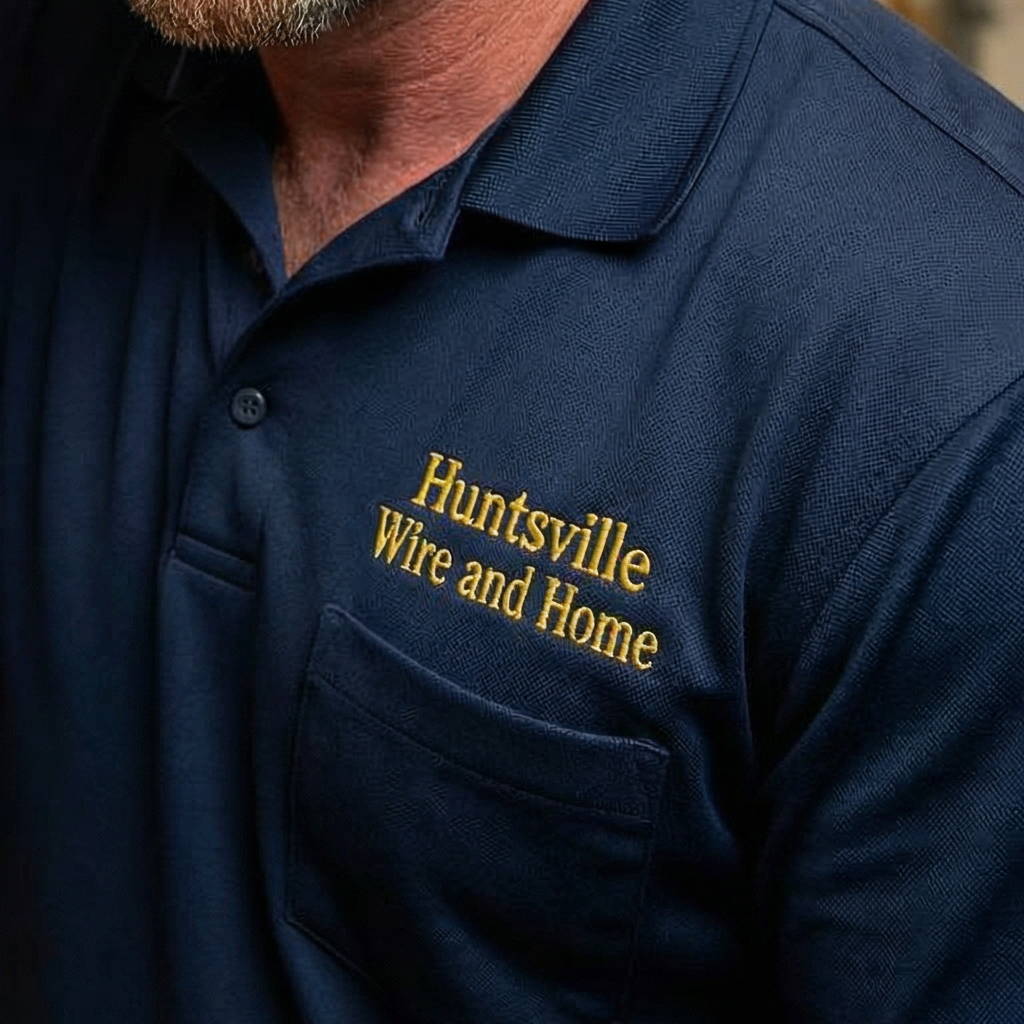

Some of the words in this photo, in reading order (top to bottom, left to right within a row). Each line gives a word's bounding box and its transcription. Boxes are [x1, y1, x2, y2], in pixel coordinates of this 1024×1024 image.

[374, 506, 453, 586] Wire
[457, 560, 535, 619] and
[536, 575, 658, 669] Home
[410, 452, 652, 592] Huntsville
